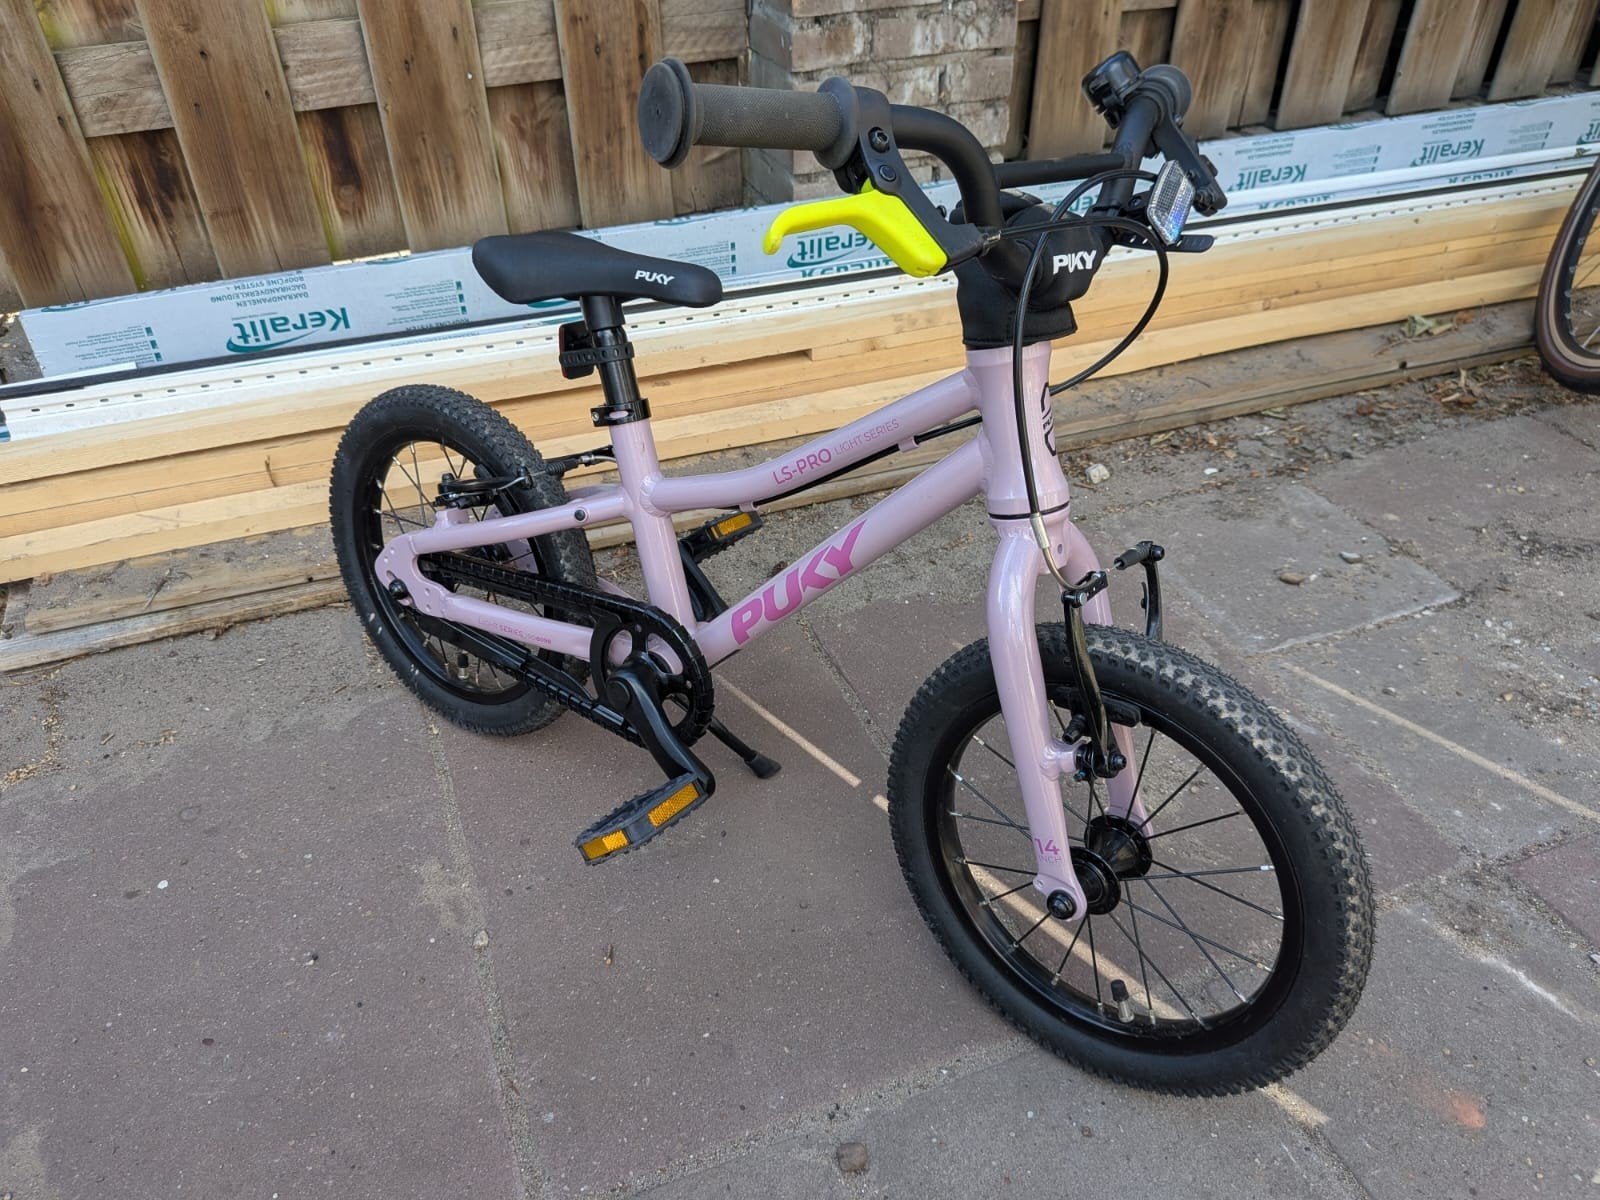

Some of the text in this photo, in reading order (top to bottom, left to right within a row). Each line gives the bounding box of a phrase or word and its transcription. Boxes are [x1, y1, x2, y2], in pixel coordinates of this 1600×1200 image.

[1420, 139, 1485, 166] Keralit
[1236, 164, 1307, 190] Keralit
[234, 281, 265, 291] SYSTEM
[634, 270, 675, 285] PUKY
[236, 291, 309, 308] DAKRANDPANELEN
[233, 307, 351, 345] Keralit
[772, 418, 900, 485] LS-PRO LIGHT SERIES
[731, 518, 868, 645] PUKY
[1034, 838, 1060, 855] 14
